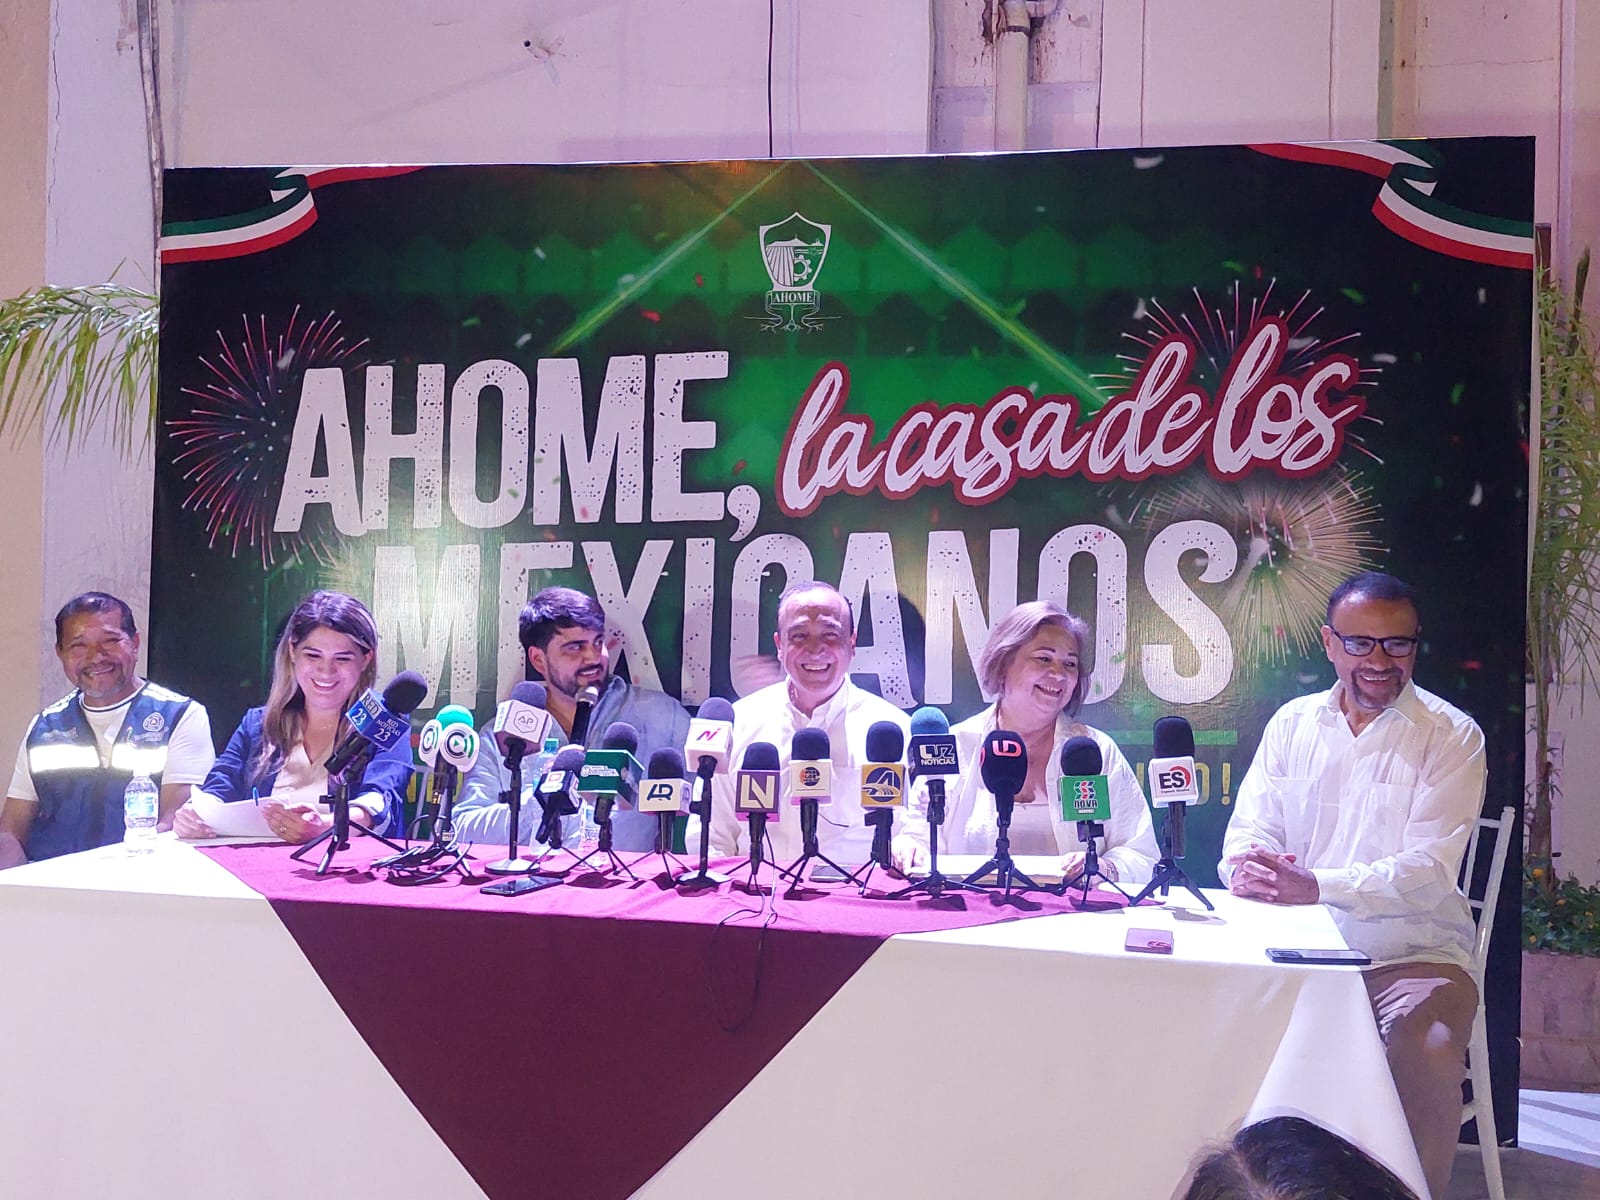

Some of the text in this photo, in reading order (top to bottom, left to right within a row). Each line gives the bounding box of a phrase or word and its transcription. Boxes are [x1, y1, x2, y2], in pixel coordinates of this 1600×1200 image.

[773, 291, 813, 303] AHOME
[273, 321, 1361, 542] AHOME, la casa de los
[351, 708, 367, 726] 23
[374, 728, 391, 742] 23
[919, 743, 955, 759] LUZ
[920, 758, 956, 766] NOTICIAS
[1158, 771, 1185, 789] ES
